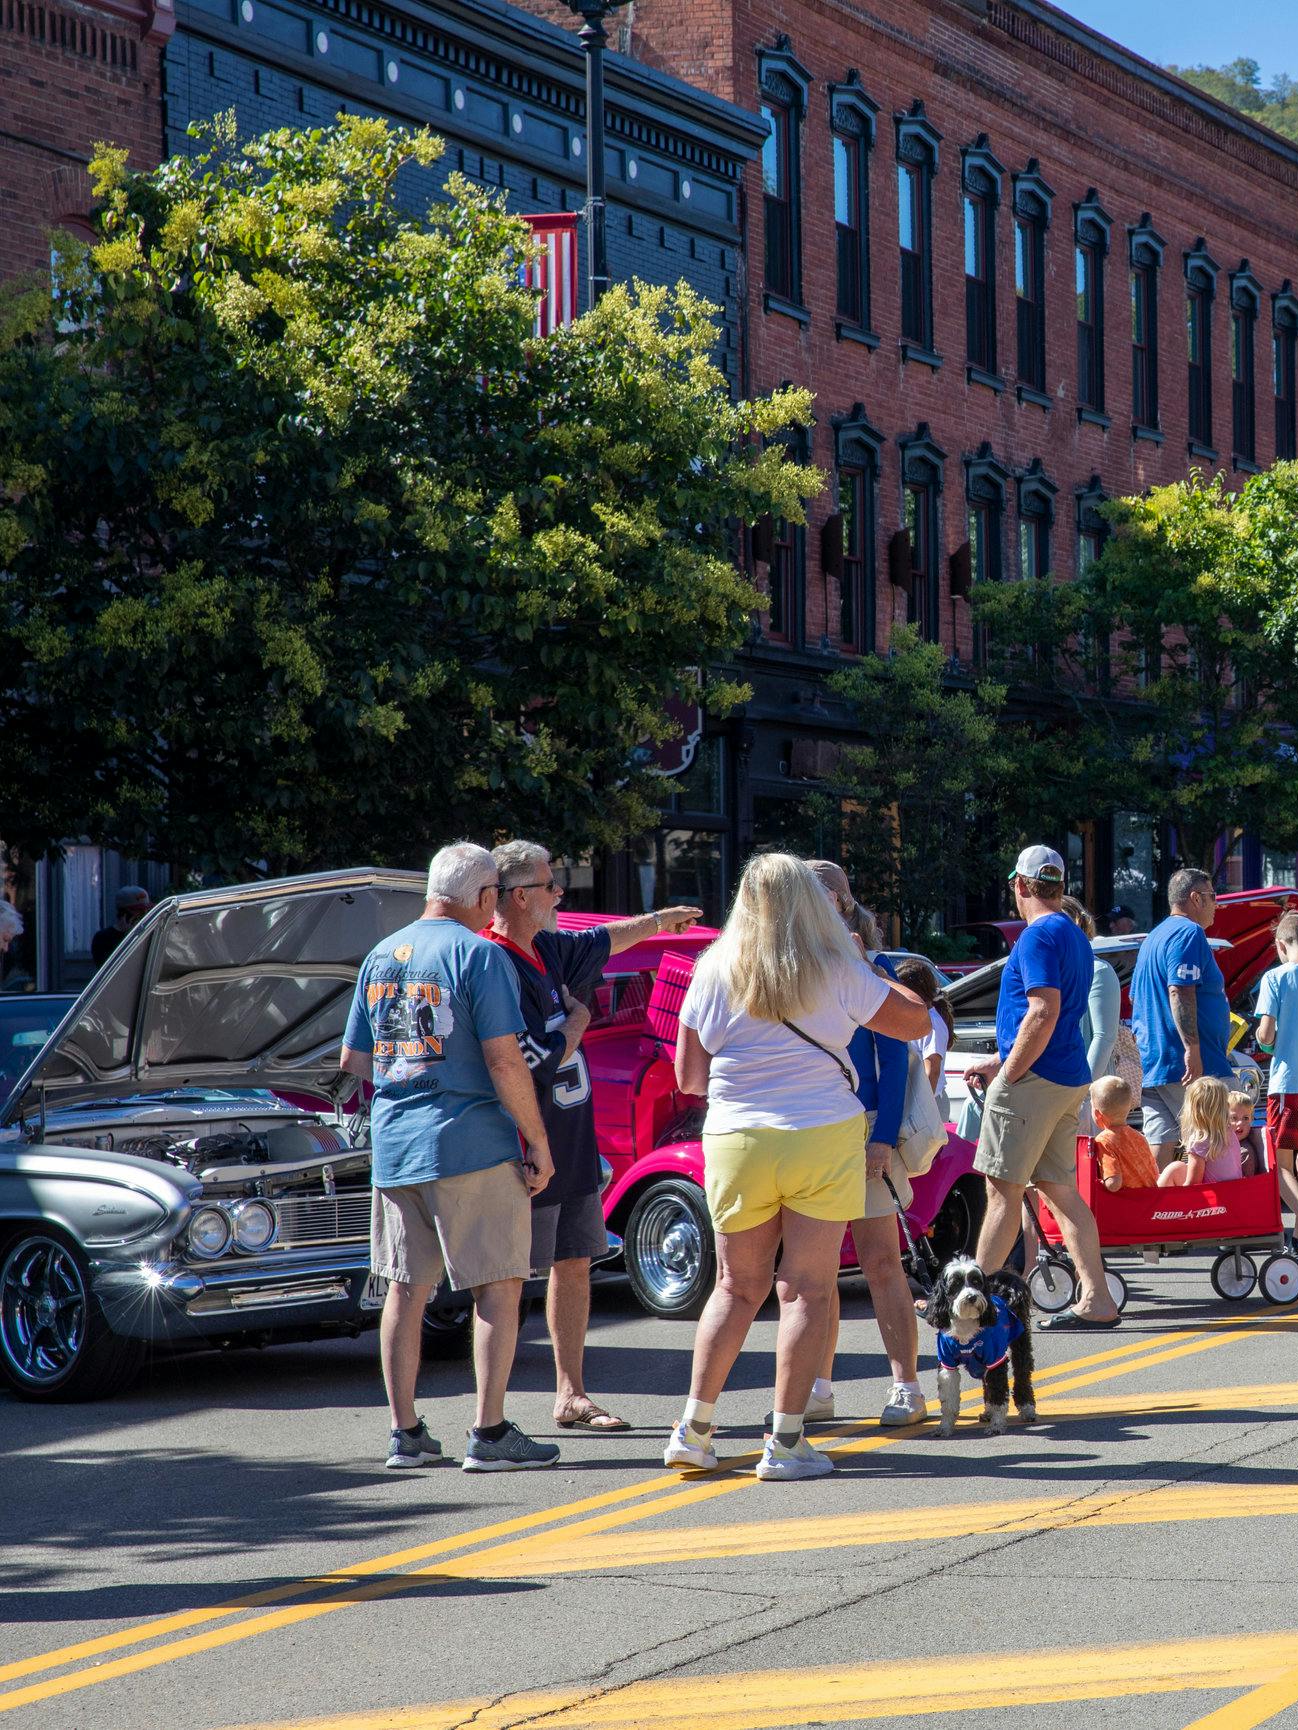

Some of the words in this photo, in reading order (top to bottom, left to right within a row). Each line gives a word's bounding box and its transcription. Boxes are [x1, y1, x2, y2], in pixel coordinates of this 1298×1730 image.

[368, 964, 442, 982] California
[413, 1078, 440, 1090] 2018
[1151, 1211, 1184, 1220] RADIO
[1196, 1206, 1227, 1218] FLYER
